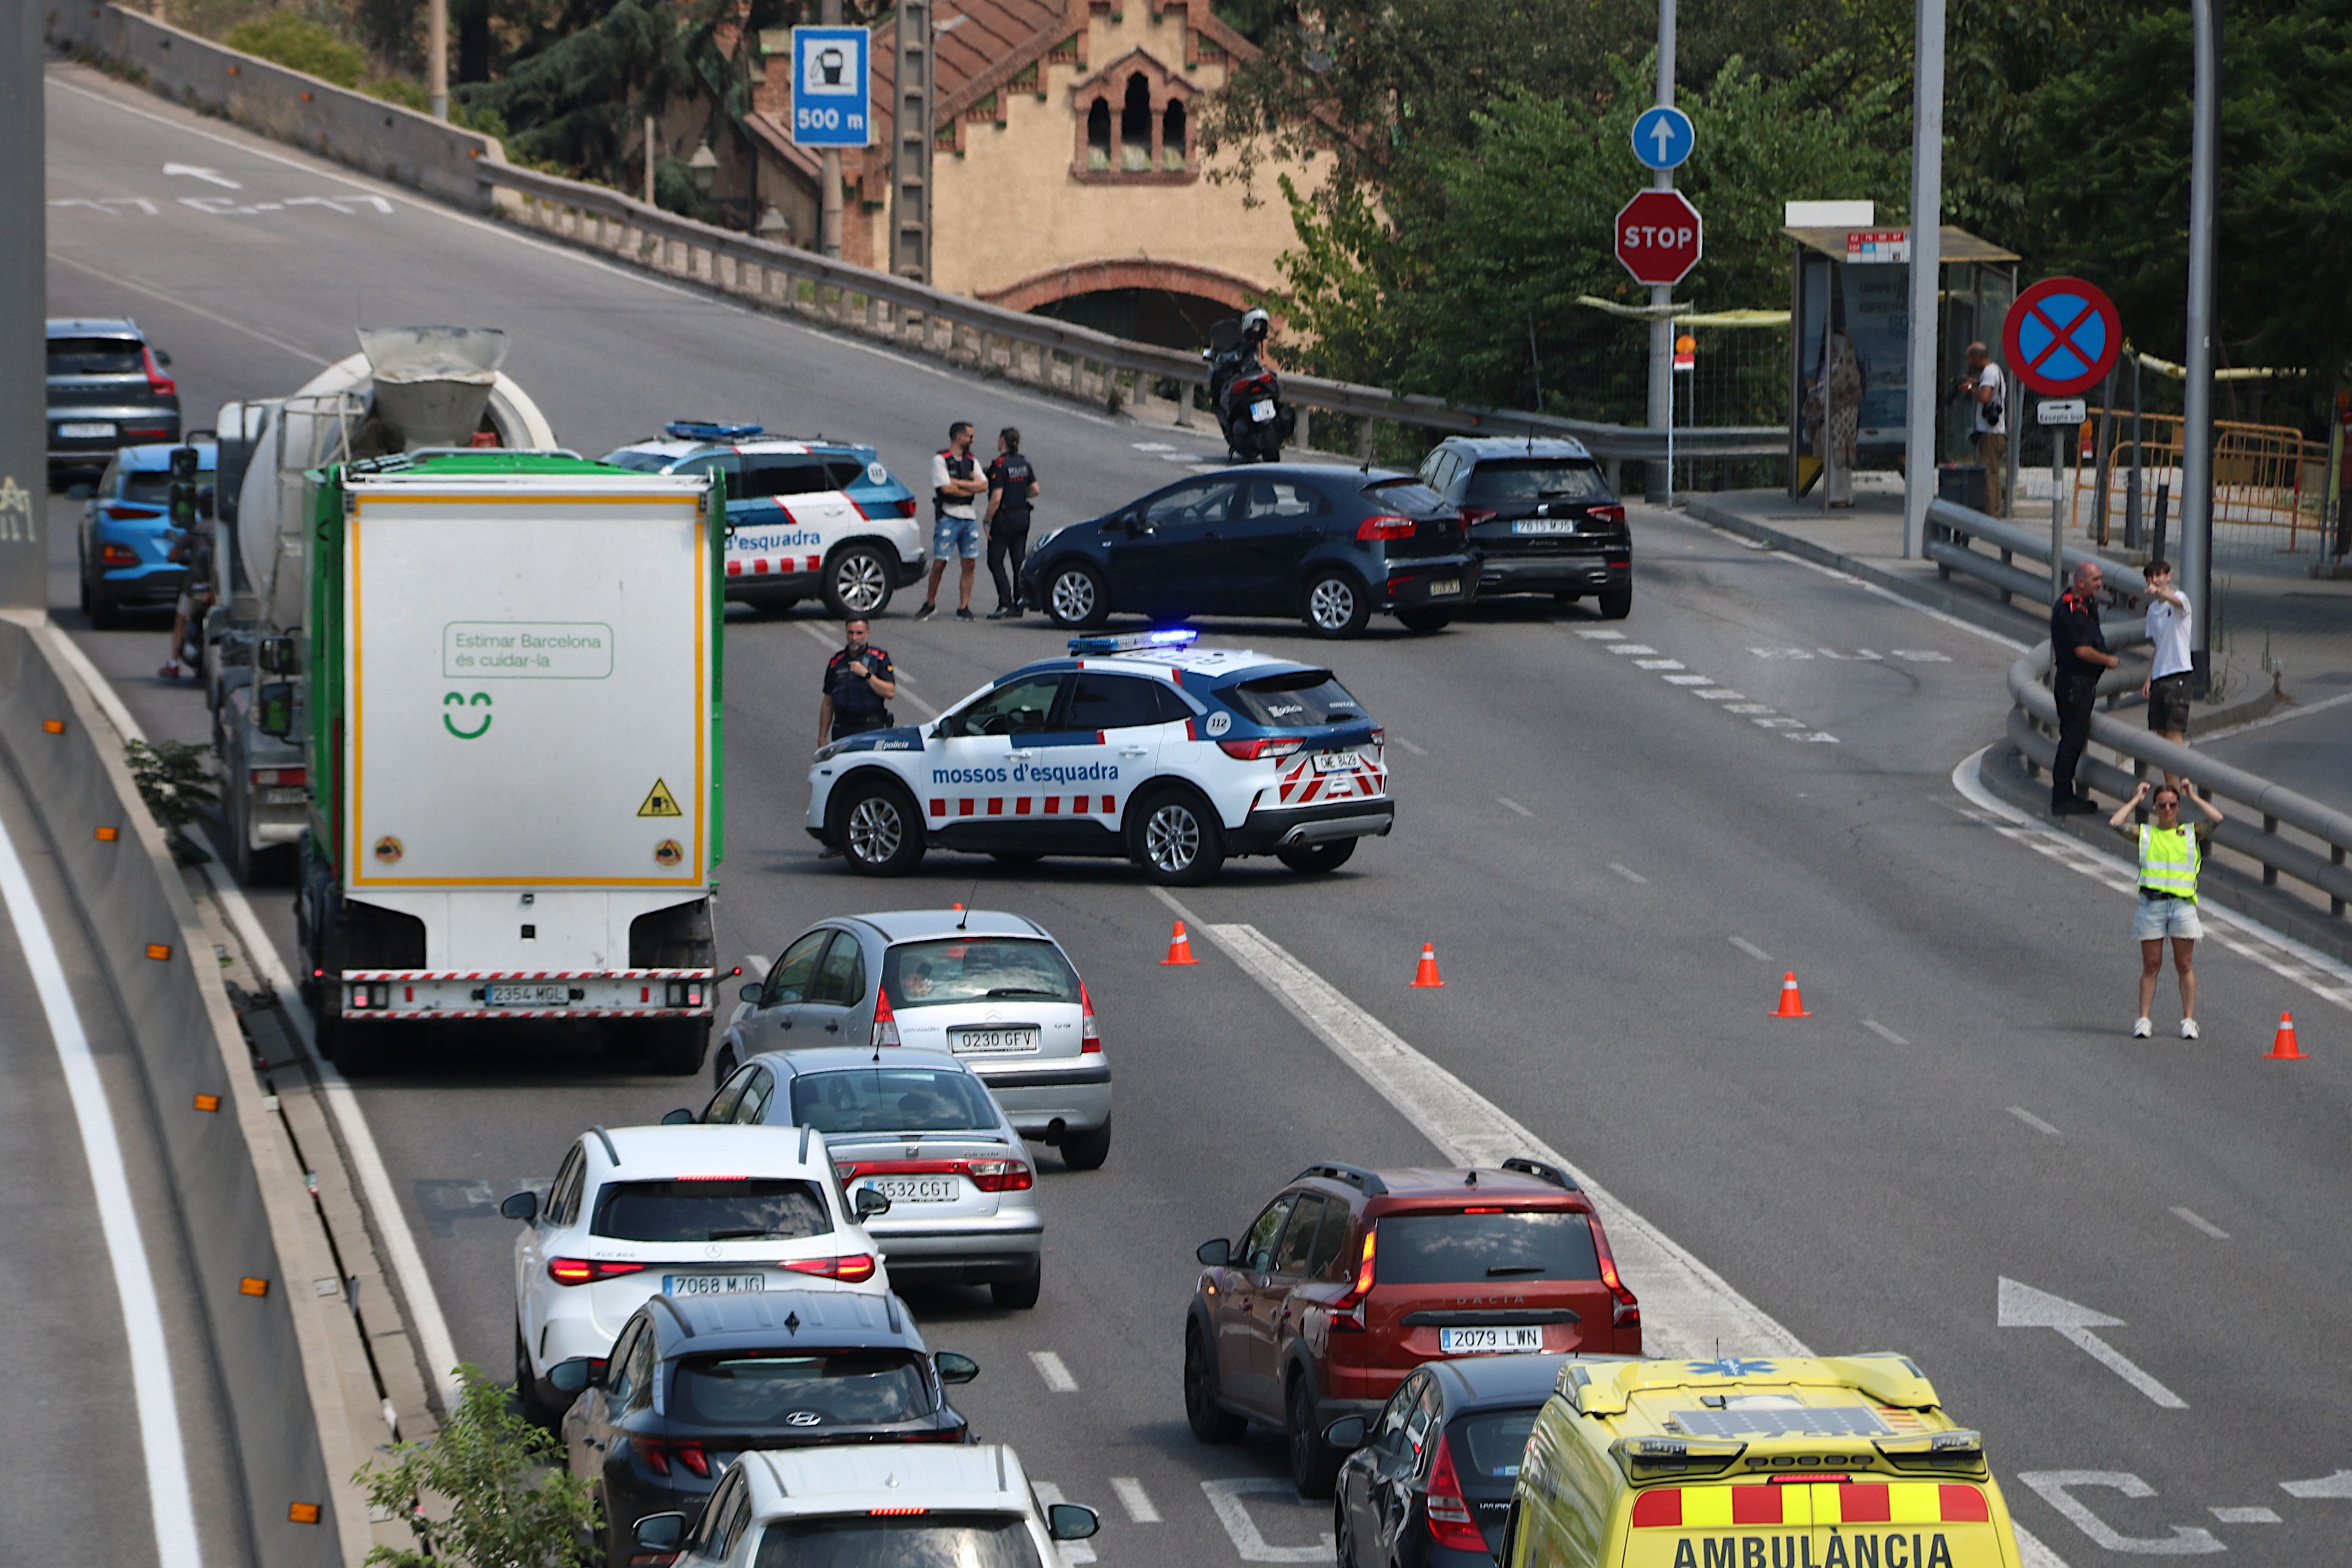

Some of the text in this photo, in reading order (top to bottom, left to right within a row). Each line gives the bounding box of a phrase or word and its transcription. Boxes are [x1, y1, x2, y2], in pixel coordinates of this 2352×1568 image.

[797, 107, 863, 129] 500 m
[1624, 226, 1692, 249] STOP
[455, 633, 601, 649] Estimar Barcelona
[455, 652, 551, 667] és cuidar-la
[1211, 718, 1227, 727] 112
[933, 761, 1119, 786] mossos d'esquadra
[494, 987, 531, 1001] 2354
[962, 1031, 1031, 1047] 0230 GFV
[878, 1181, 951, 1197] 3532 CGT
[676, 1276, 760, 1293] 7068 MJG
[1457, 1295, 1525, 1305] DACIA
[1455, 1329, 1537, 1347] 2079 LWN
[1672, 1526, 1954, 1568] AMBULÀNCIA
